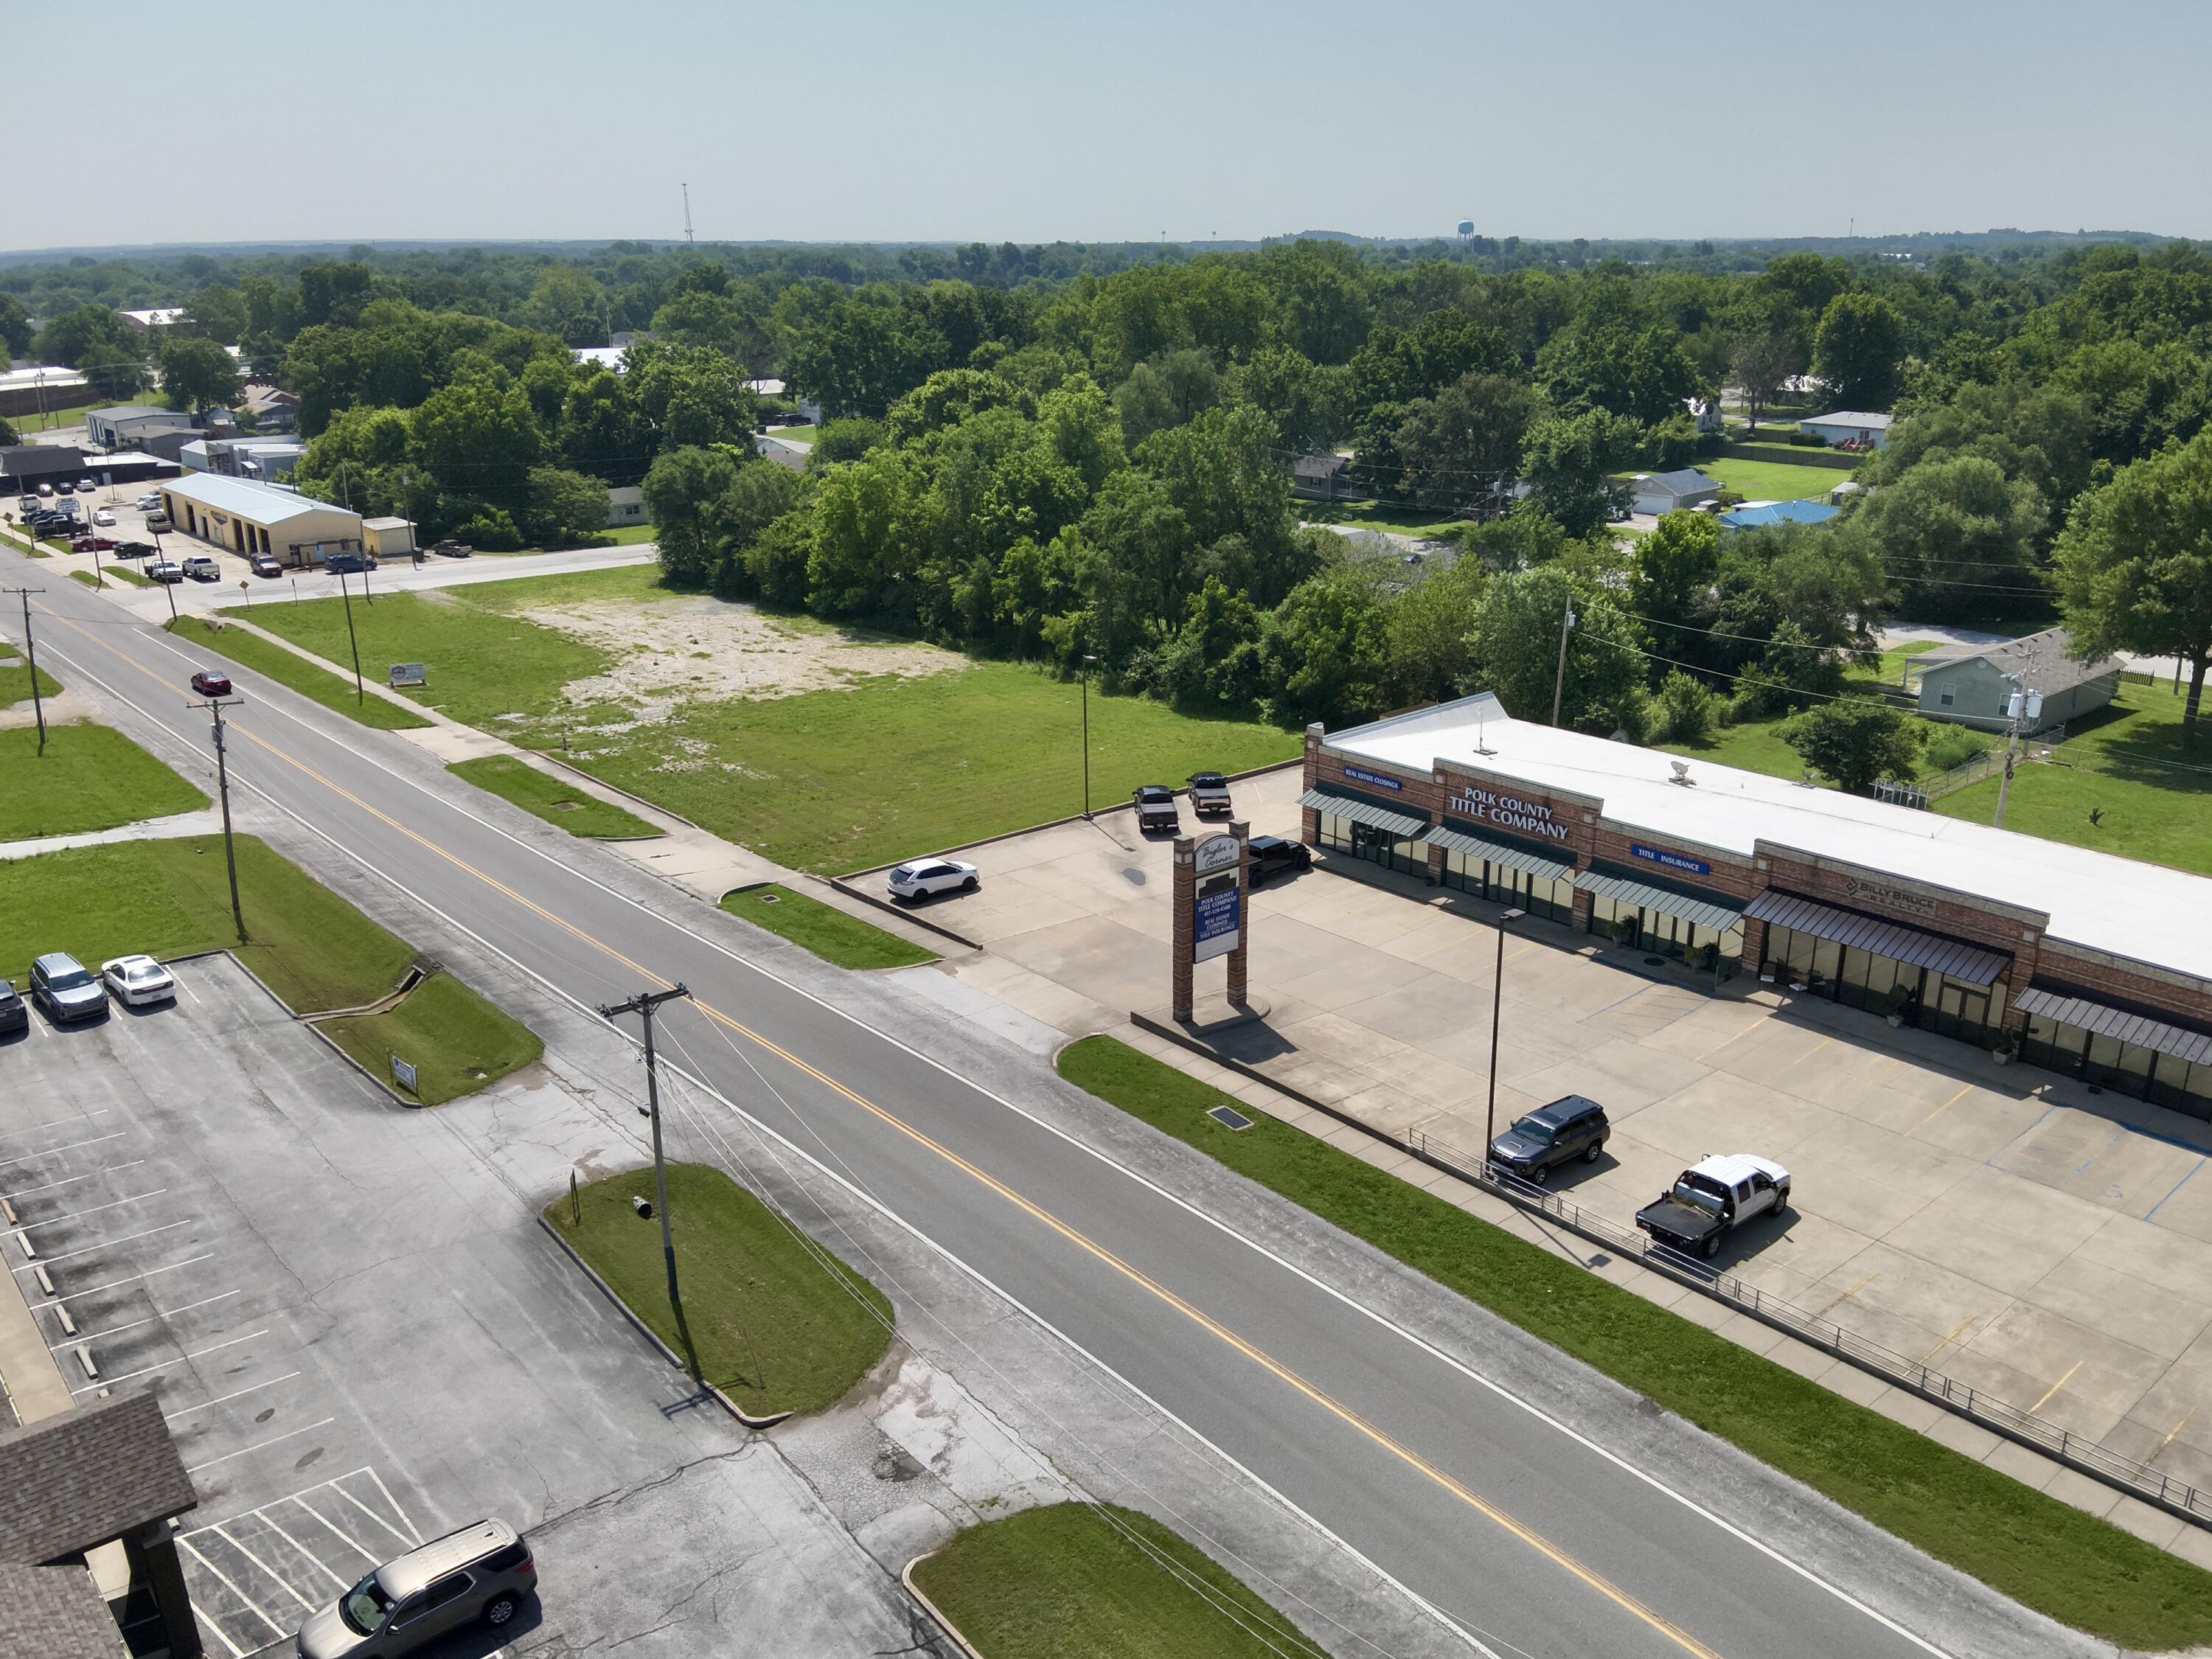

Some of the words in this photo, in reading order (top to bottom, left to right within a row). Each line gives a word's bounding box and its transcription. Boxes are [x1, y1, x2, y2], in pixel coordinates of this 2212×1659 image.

[1346, 769, 1357, 777] REAL
[1358, 773, 1374, 782] ESTATE
[1374, 777, 1398, 789] CLOSINGS
[1465, 787, 1496, 805] POLK
[1500, 797, 1552, 819] COUNTY
[1450, 796, 1486, 818] TITLE
[1491, 809, 1568, 840] COMPANY
[1203, 840, 1234, 858] Bigler's
[1206, 855, 1232, 867] Corner
[1638, 849, 1655, 859] TITLE
[1660, 855, 1700, 872] INSURANCE
[1197, 904, 1211, 912] TITLE
[1211, 896, 1237, 908] COMPANY
[1201, 897, 1214, 905] POLK
[1214, 891, 1234, 900] COUNTY
[1860, 883, 1891, 897] BILLY
[1893, 891, 1934, 908] BRUCE
[1870, 895, 1921, 912] REALTY
[1211, 923, 1235, 935] INSURANCE
